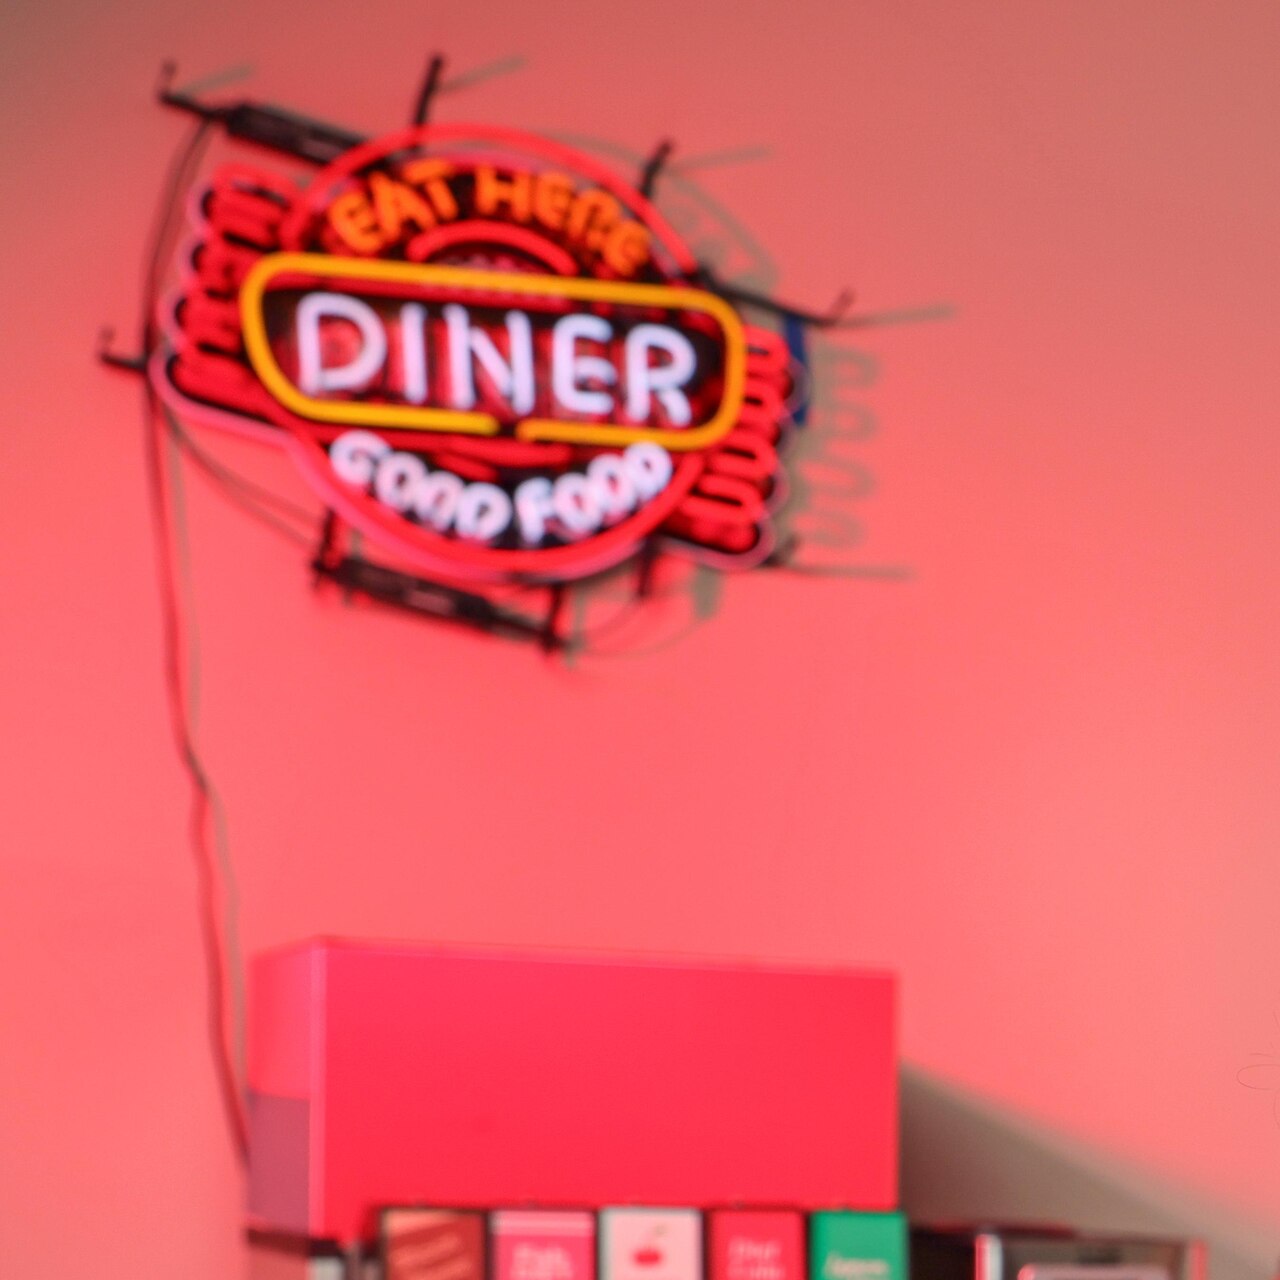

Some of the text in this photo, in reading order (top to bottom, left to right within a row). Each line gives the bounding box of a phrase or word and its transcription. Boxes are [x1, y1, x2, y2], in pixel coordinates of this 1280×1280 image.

[328, 158, 649, 276] EAT HERE
[296, 292, 698, 427] DINER
[329, 430, 673, 546] GOOD FOOD
